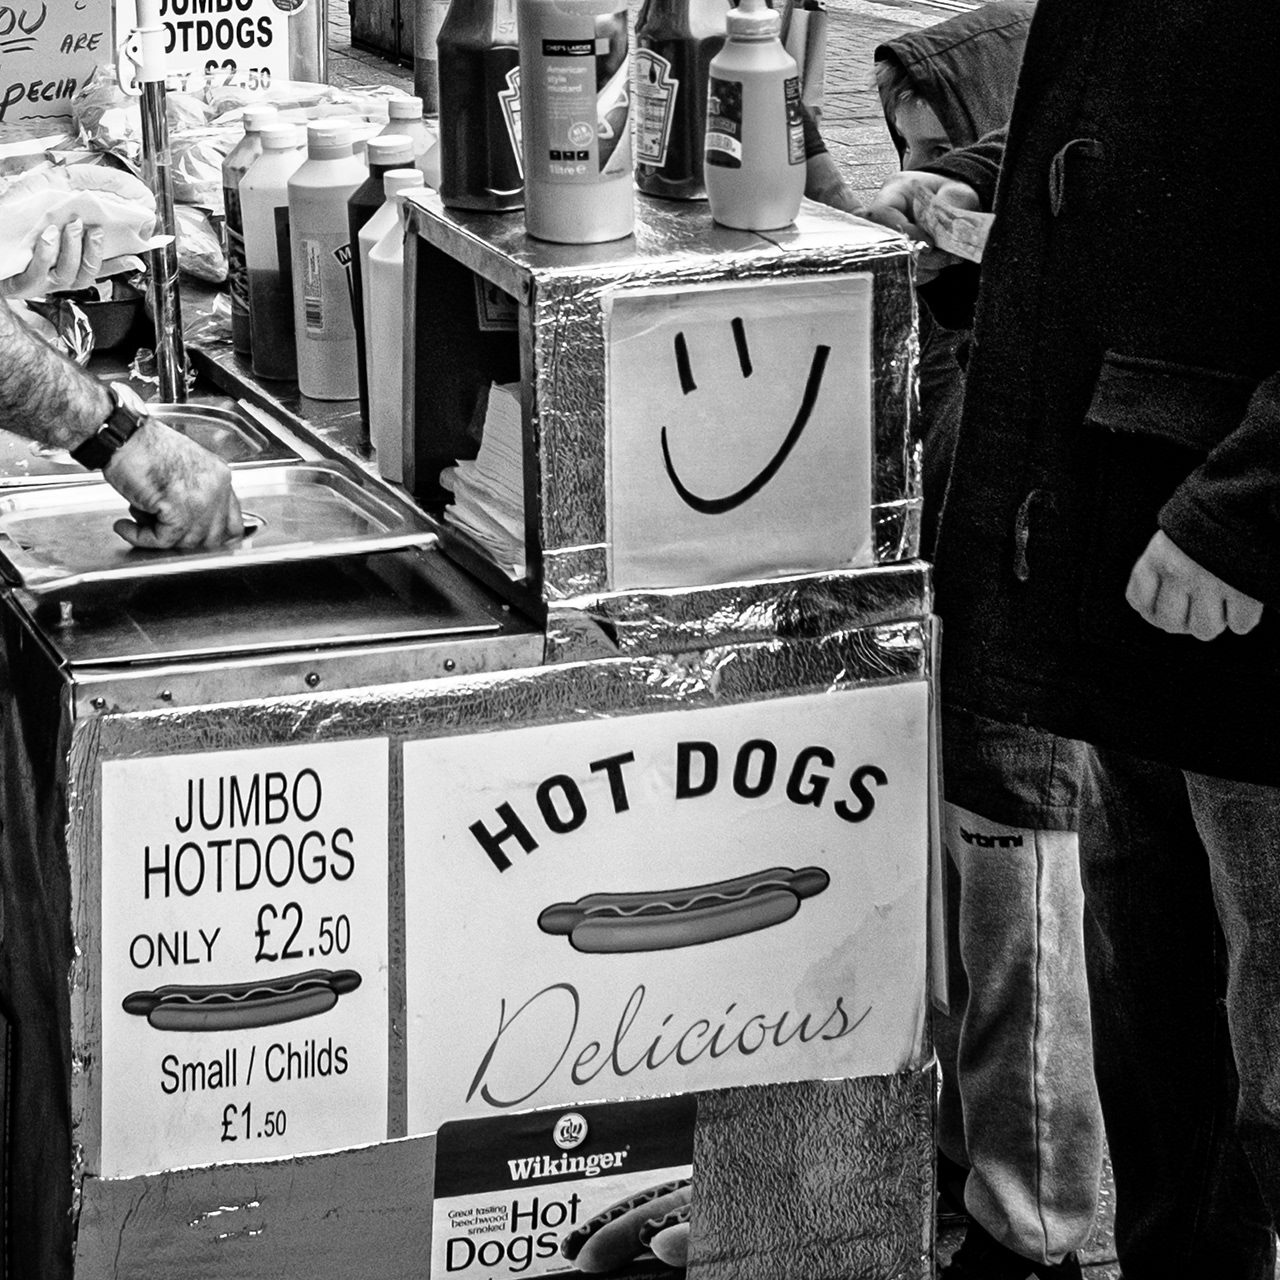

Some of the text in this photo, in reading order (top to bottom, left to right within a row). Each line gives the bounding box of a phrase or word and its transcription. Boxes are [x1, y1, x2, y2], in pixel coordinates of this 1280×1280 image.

[60, 32, 104, 55] ARE
[164, 15, 273, 54] OTDOGS
[175, 768, 322, 833] JUMBO
[467, 737, 889, 873] HOT DOGS
[144, 827, 355, 900] HOTDOGS
[129, 901, 351, 969] ONLY £2.50
[161, 1048, 237, 1095] Small
[265, 1037, 349, 1083] Childs
[463, 981, 873, 1110] Delicious
[221, 1101, 287, 1142] £1.50
[508, 1150, 628, 1181] Wikinger
[448, 1203, 508, 1219] Great tasting
[451, 1213, 509, 1228] beechwood
[467, 1222, 506, 1236] smoked
[511, 1193, 582, 1233] Hot
[446, 1231, 559, 1273] Dogs
